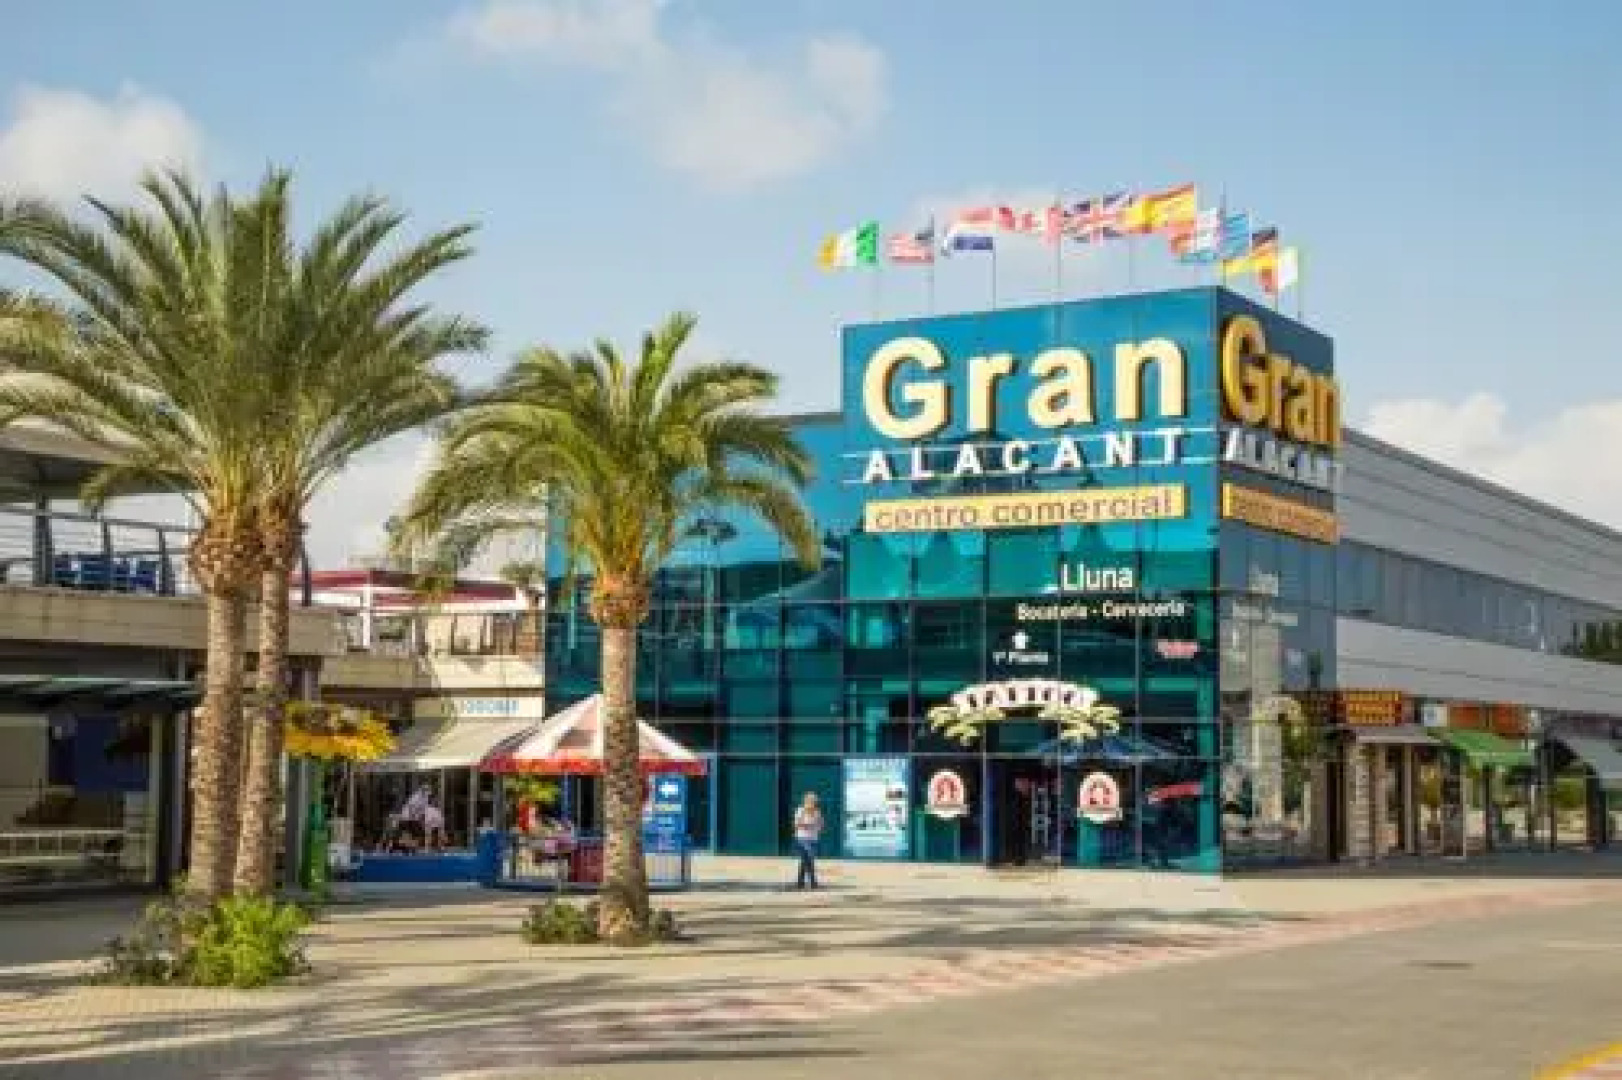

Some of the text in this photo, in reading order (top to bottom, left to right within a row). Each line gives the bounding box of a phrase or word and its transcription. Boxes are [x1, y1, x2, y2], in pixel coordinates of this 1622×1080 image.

[863, 336, 1187, 440] Gran
[1222, 315, 1340, 443] Gran
[864, 428, 1184, 482] ALACANT
[875, 489, 1172, 530] centro comercial
[1063, 563, 1133, 591] Lluna
